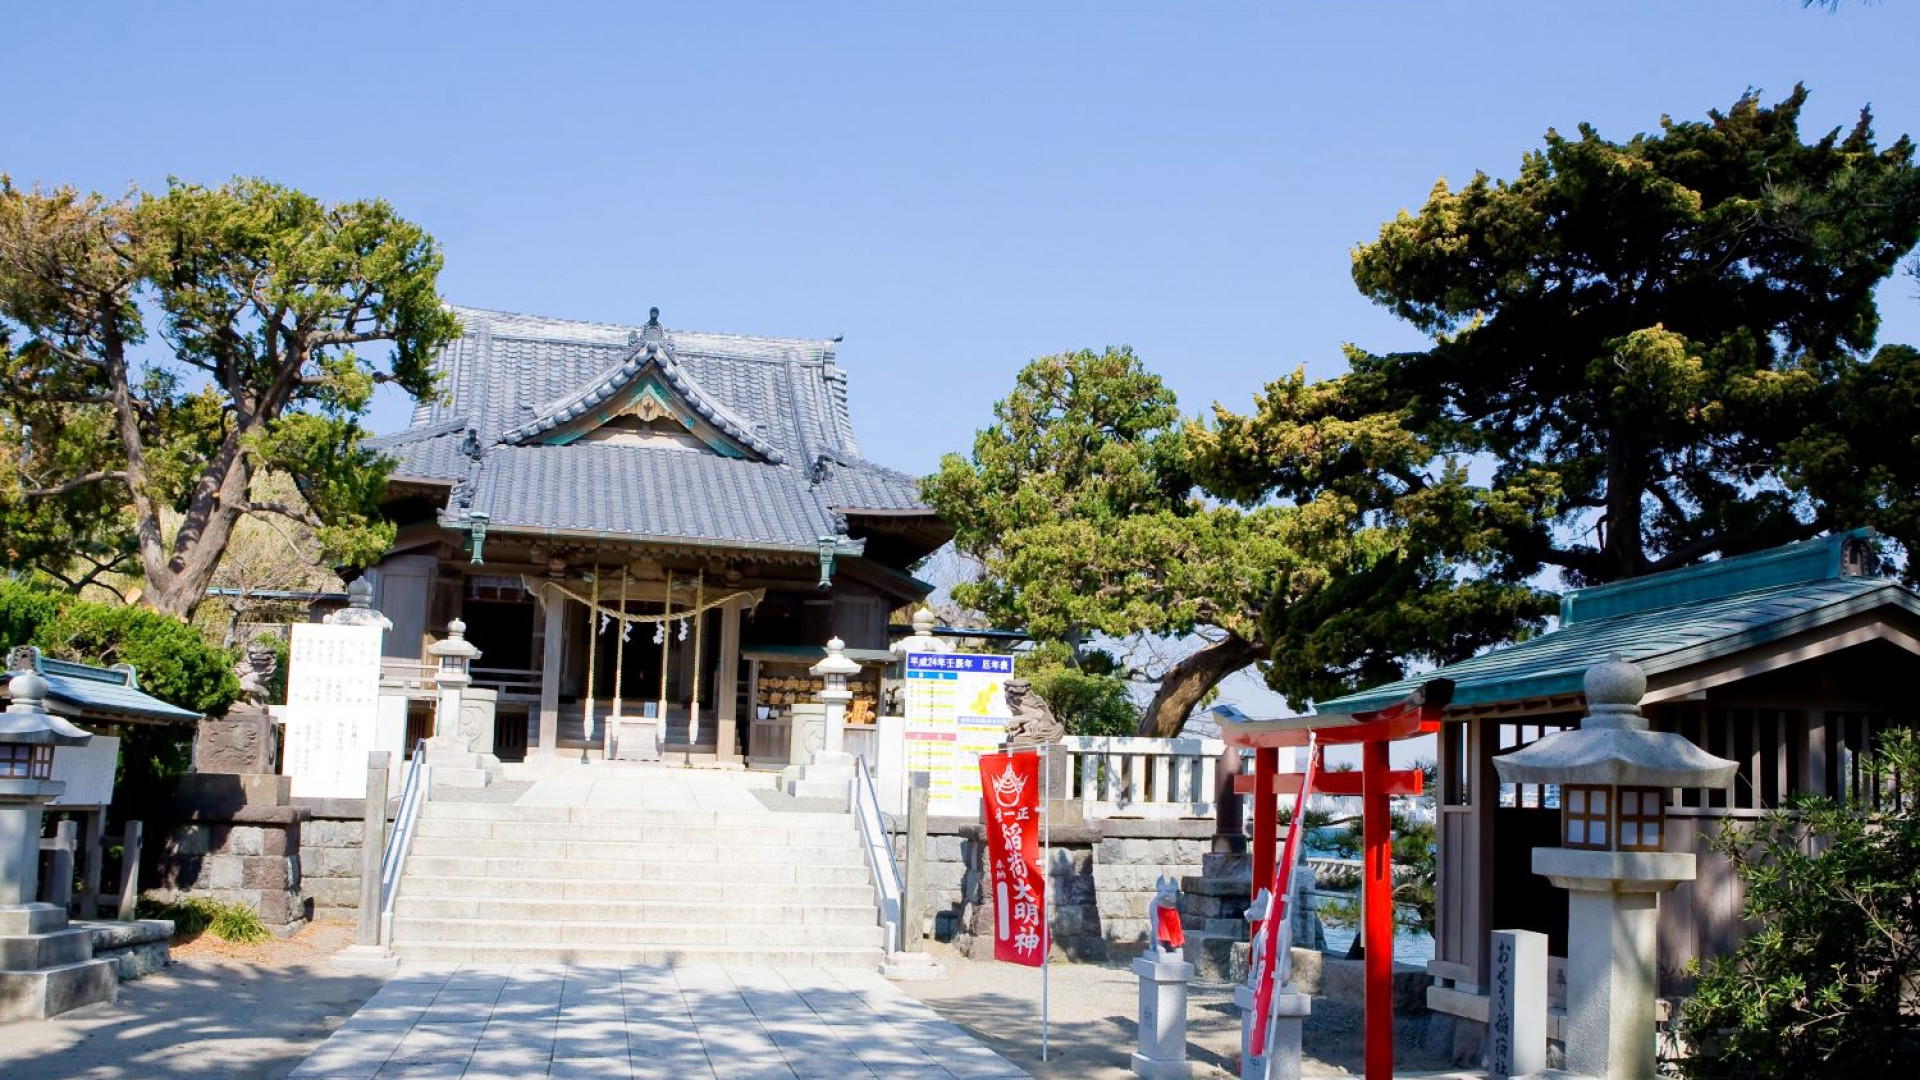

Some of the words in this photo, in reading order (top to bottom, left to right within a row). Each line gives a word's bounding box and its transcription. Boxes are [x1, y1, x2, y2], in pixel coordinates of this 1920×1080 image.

[1001, 822, 1040, 958] 稲荷大明神
